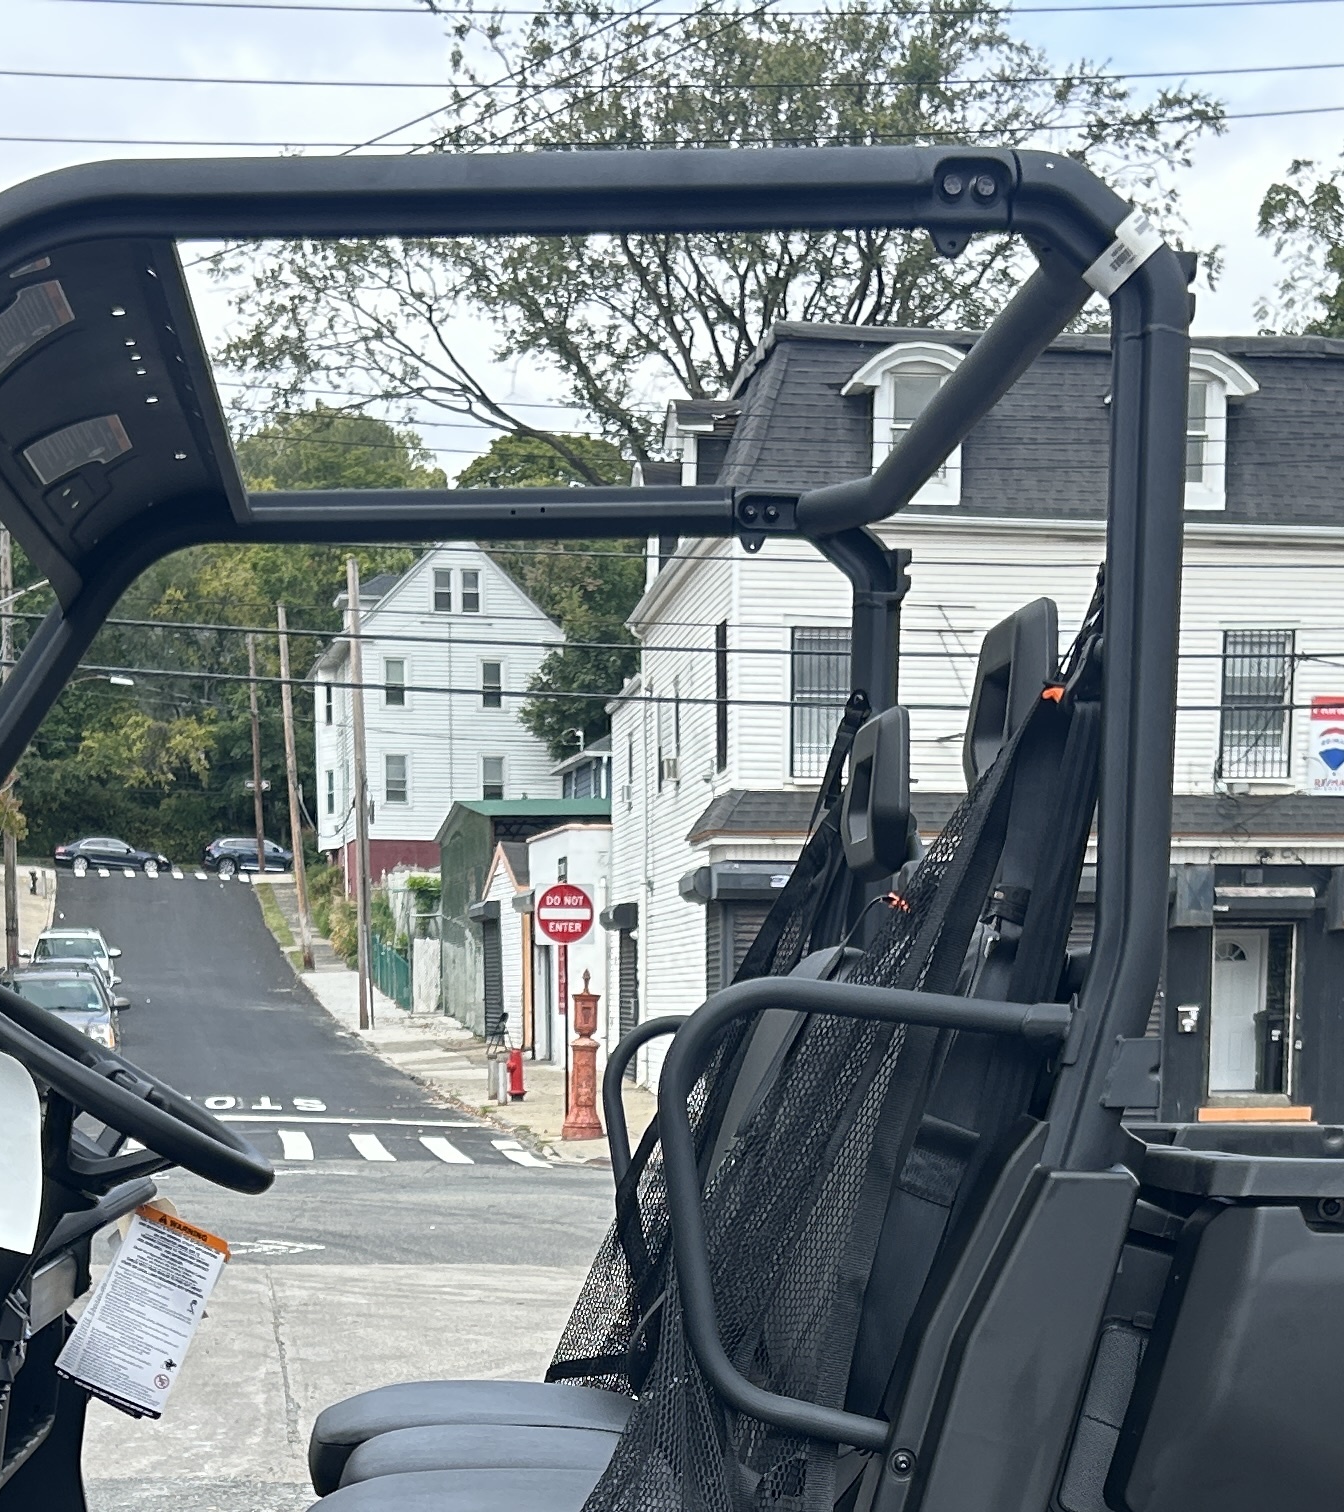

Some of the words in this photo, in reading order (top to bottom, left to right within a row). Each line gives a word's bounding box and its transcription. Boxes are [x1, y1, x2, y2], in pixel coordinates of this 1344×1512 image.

[546, 895, 561, 906] DO
[563, 896, 584, 906] NOT
[548, 922, 582, 933] ENTER
[184, 1095, 327, 1112] STO
[170, 1219, 208, 1242] WARNING
